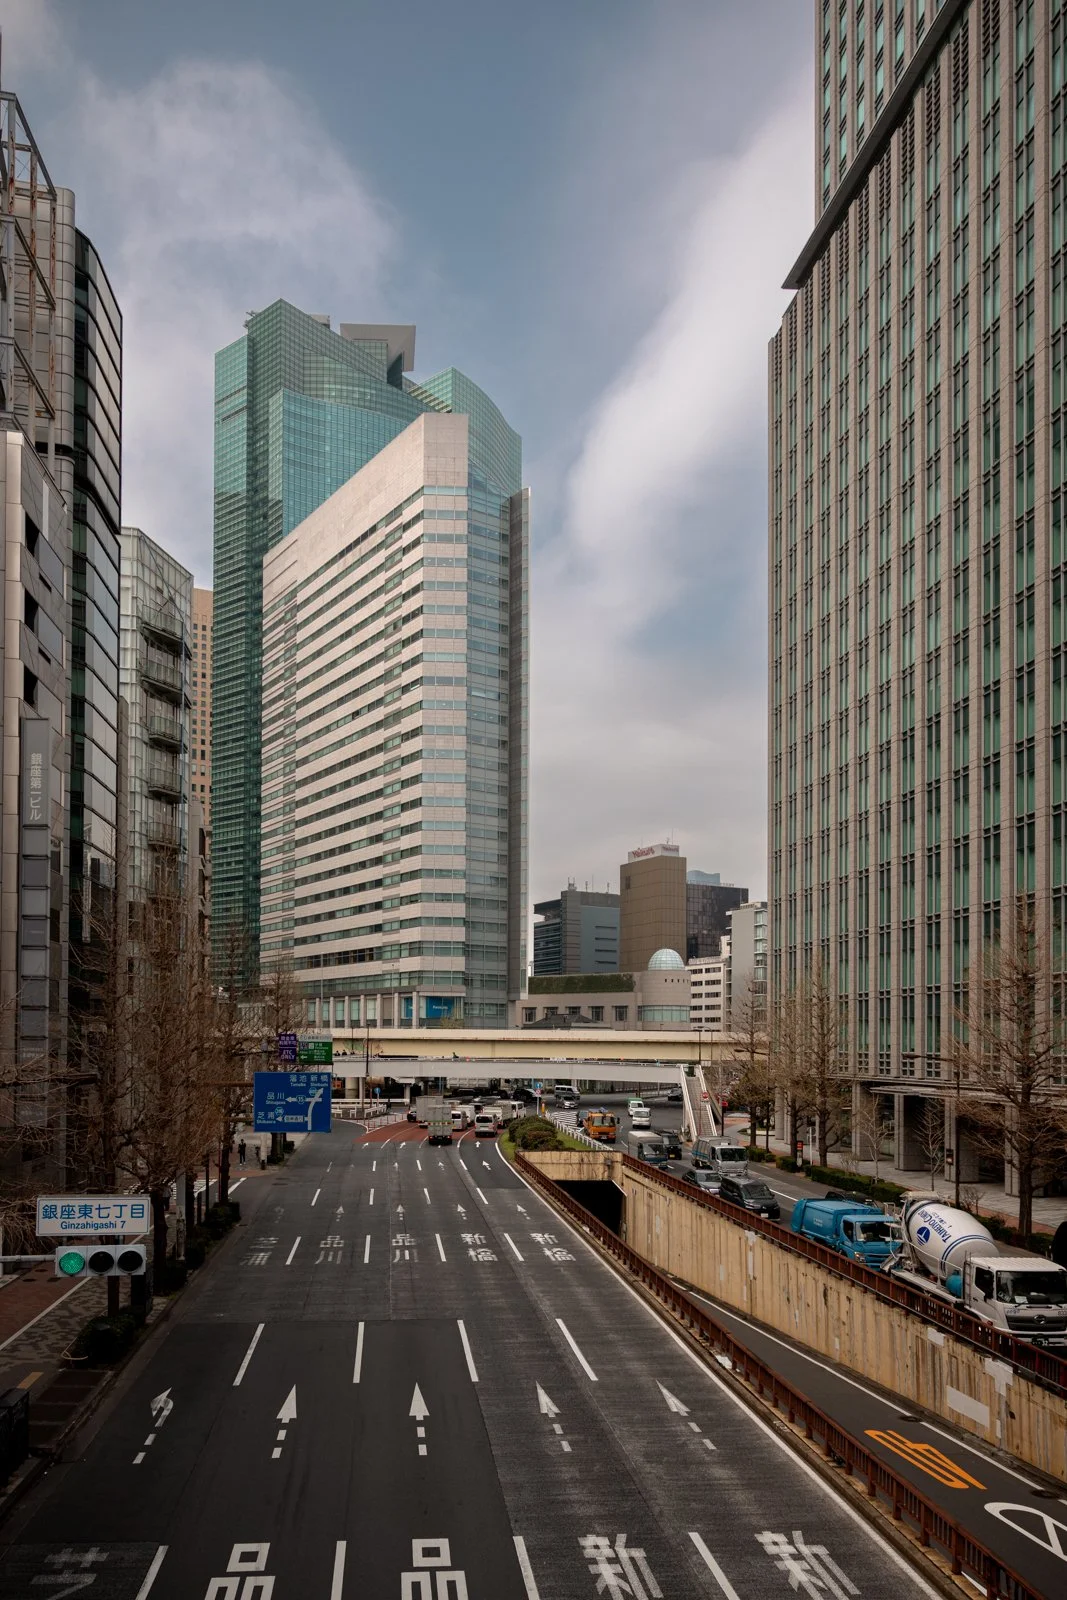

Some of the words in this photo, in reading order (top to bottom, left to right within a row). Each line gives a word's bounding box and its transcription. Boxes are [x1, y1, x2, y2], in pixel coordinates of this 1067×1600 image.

[29, 752, 43, 821] 銀座第一ビル
[267, 1092, 285, 1100] 品川
[42, 1203, 145, 1220] 銀座東七丁目
[60, 1220, 117, 1231] Ginzahigashi
[120, 1220, 126, 1229] 7
[315, 1235, 345, 1265] 品川
[391, 1233, 419, 1263] 品川
[461, 1232, 498, 1262] 新橋
[529, 1232, 577, 1262] 新橋
[577, 1532, 664, 1600] 新
[754, 1530, 862, 1600] 新
